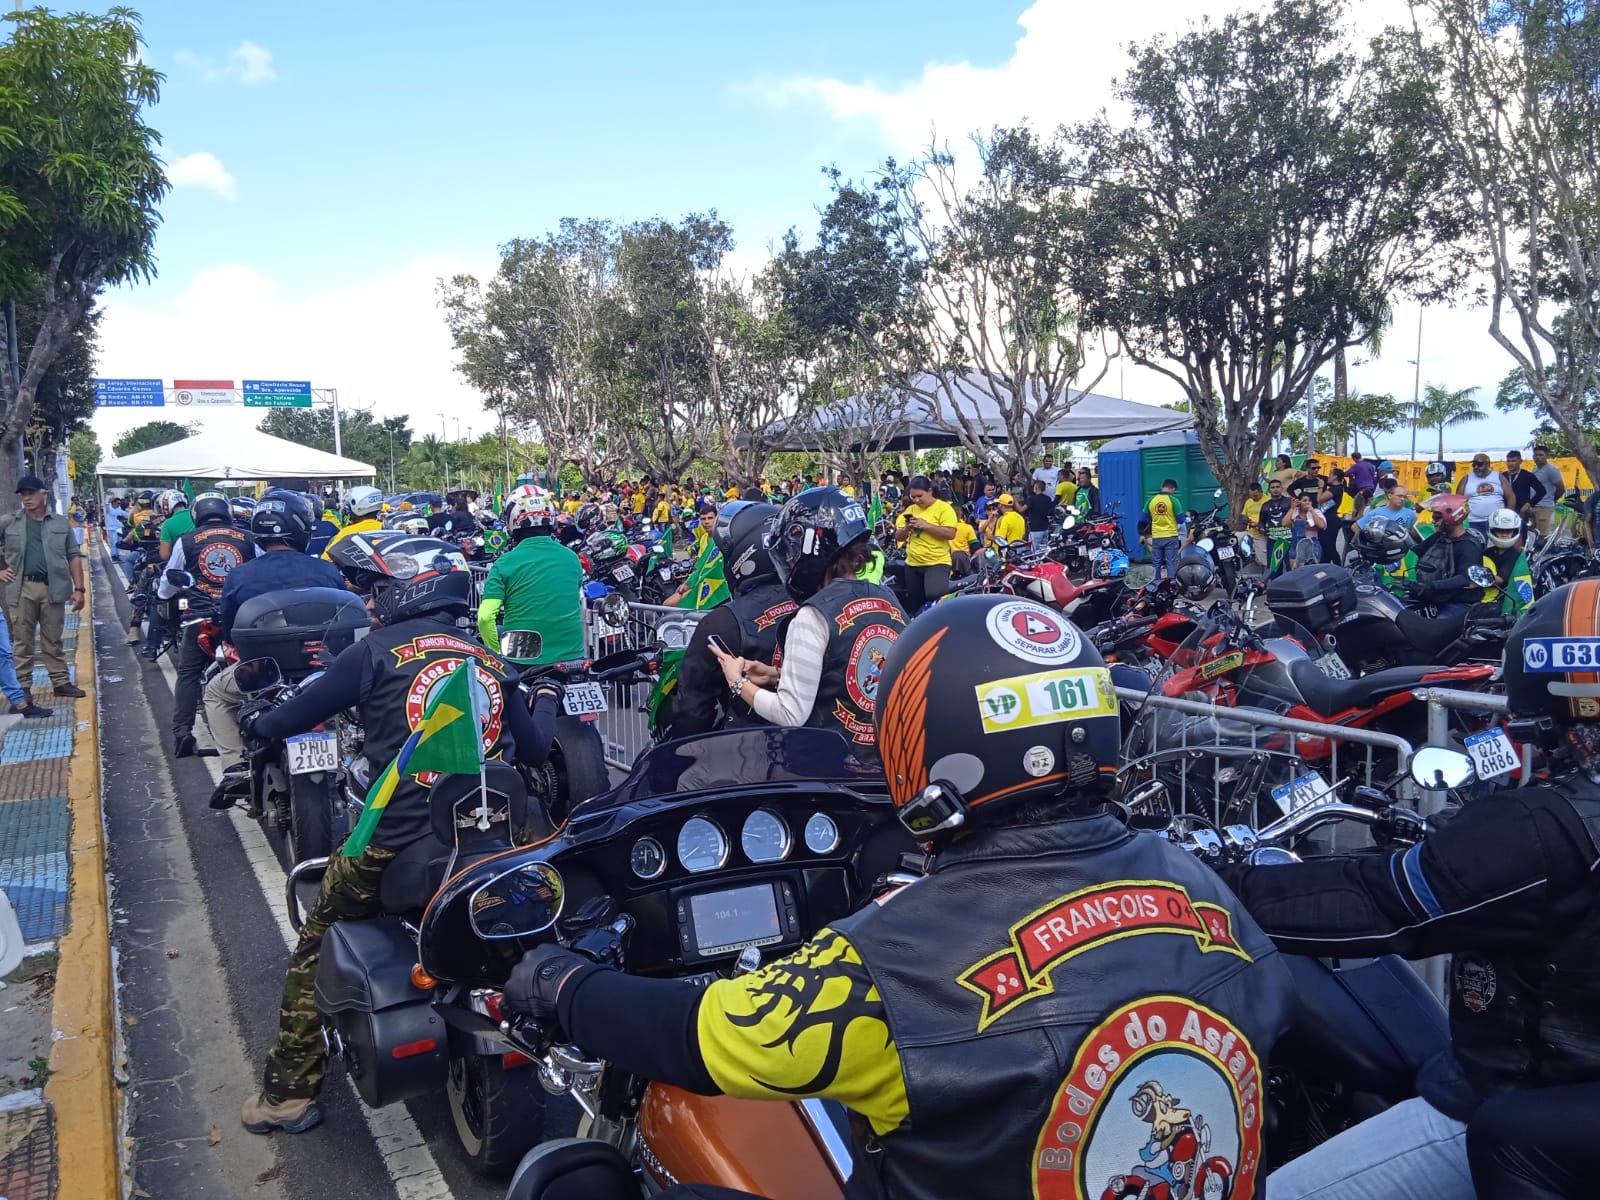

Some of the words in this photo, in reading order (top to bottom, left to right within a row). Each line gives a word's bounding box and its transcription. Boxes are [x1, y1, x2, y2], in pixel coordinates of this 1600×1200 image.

[769, 603, 799, 617] DOUGL
[849, 600, 879, 615] ANDRÉIA
[865, 628, 876, 638] do
[419, 638, 445, 648] JUNIOR
[1014, 638, 1057, 654] SEPARAR
[1528, 648, 1545, 663] AG
[408, 663, 445, 705] Bodes
[566, 689, 599, 702] PHG
[857, 696, 876, 710] Mot
[986, 693, 1017, 714] VP
[1043, 677, 1089, 710] 161
[568, 699, 604, 713] 8792
[858, 734, 875, 743] BRA
[298, 740, 329, 755] PHU
[1478, 738, 1502, 758] QZP
[1481, 751, 1514, 775] 6H86
[714, 909, 738, 920] 104.1
[1032, 894, 1159, 952] FRANÇOIS
[1039, 1043, 1121, 1171] Bodes
[1123, 1011, 1168, 1049] do
[1180, 1009, 1257, 1129] Asfalto
